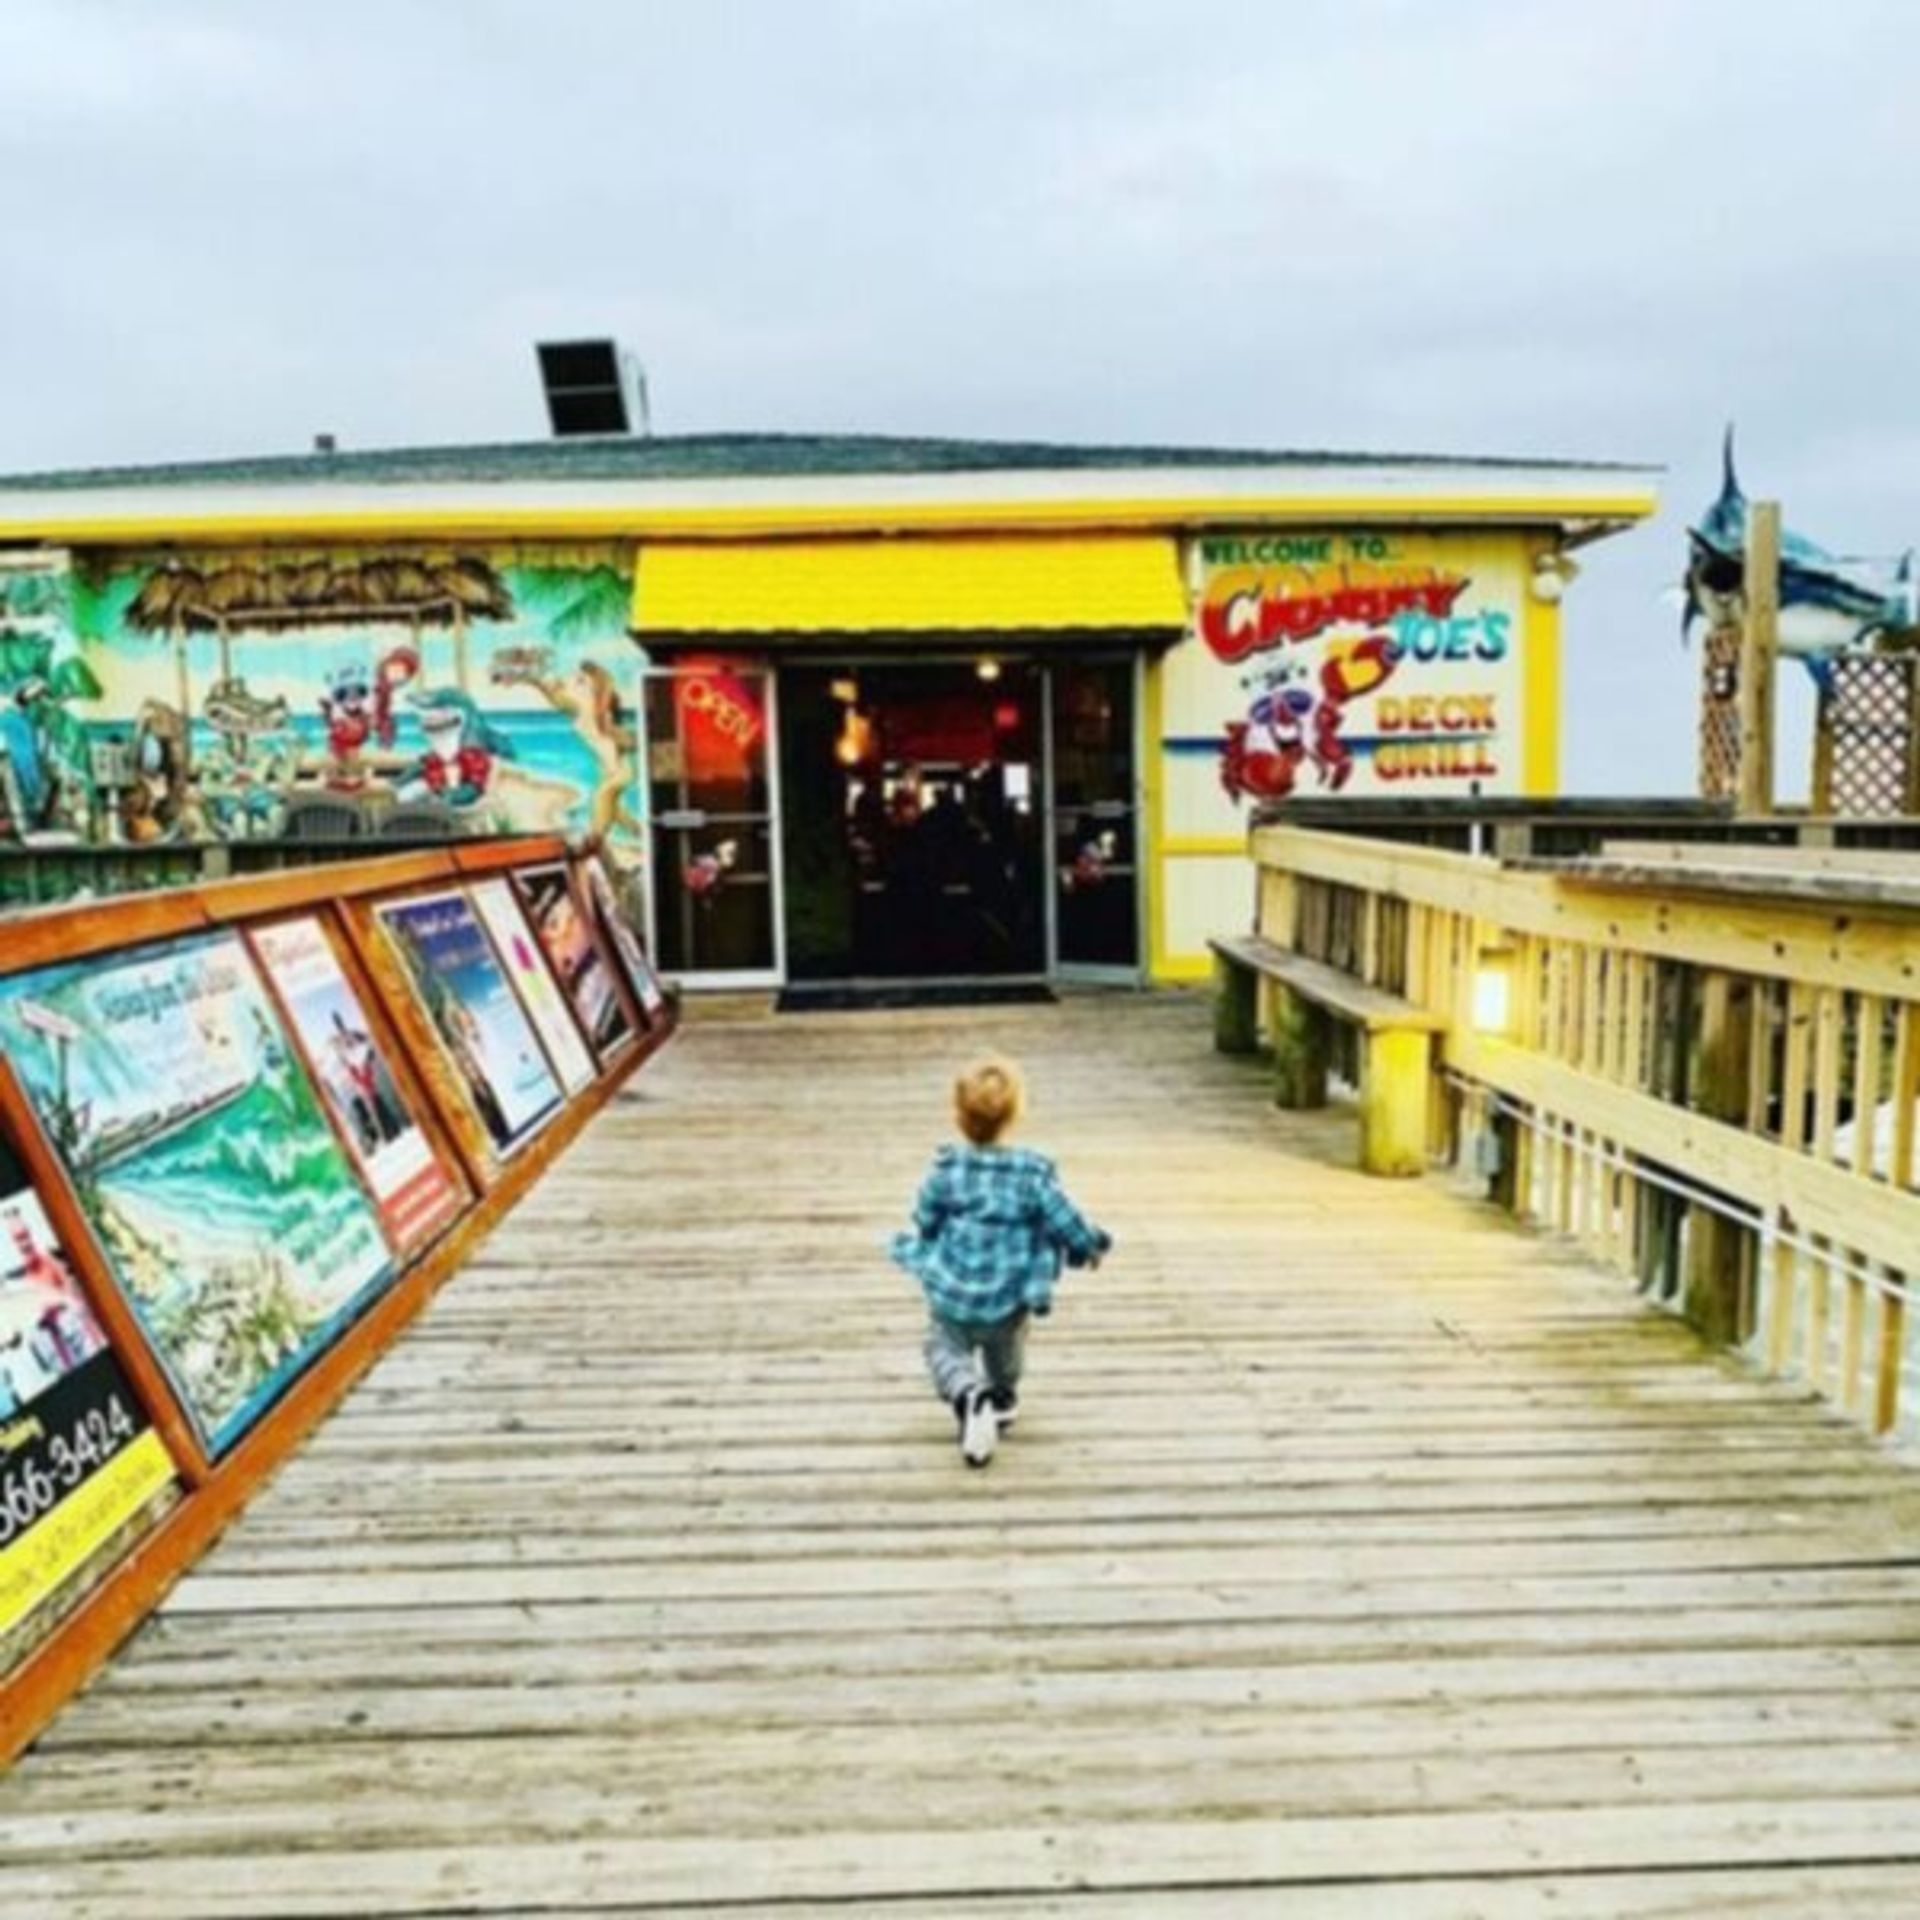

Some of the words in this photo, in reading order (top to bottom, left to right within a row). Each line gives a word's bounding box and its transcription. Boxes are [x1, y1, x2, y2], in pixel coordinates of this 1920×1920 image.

[1202, 537, 1330, 564] WELCOME
[1383, 608, 1511, 663] JOE'S
[680, 677, 762, 749] OPEN
[1375, 694, 1498, 732] DECK
[1374, 741, 1498, 781] GRILL
